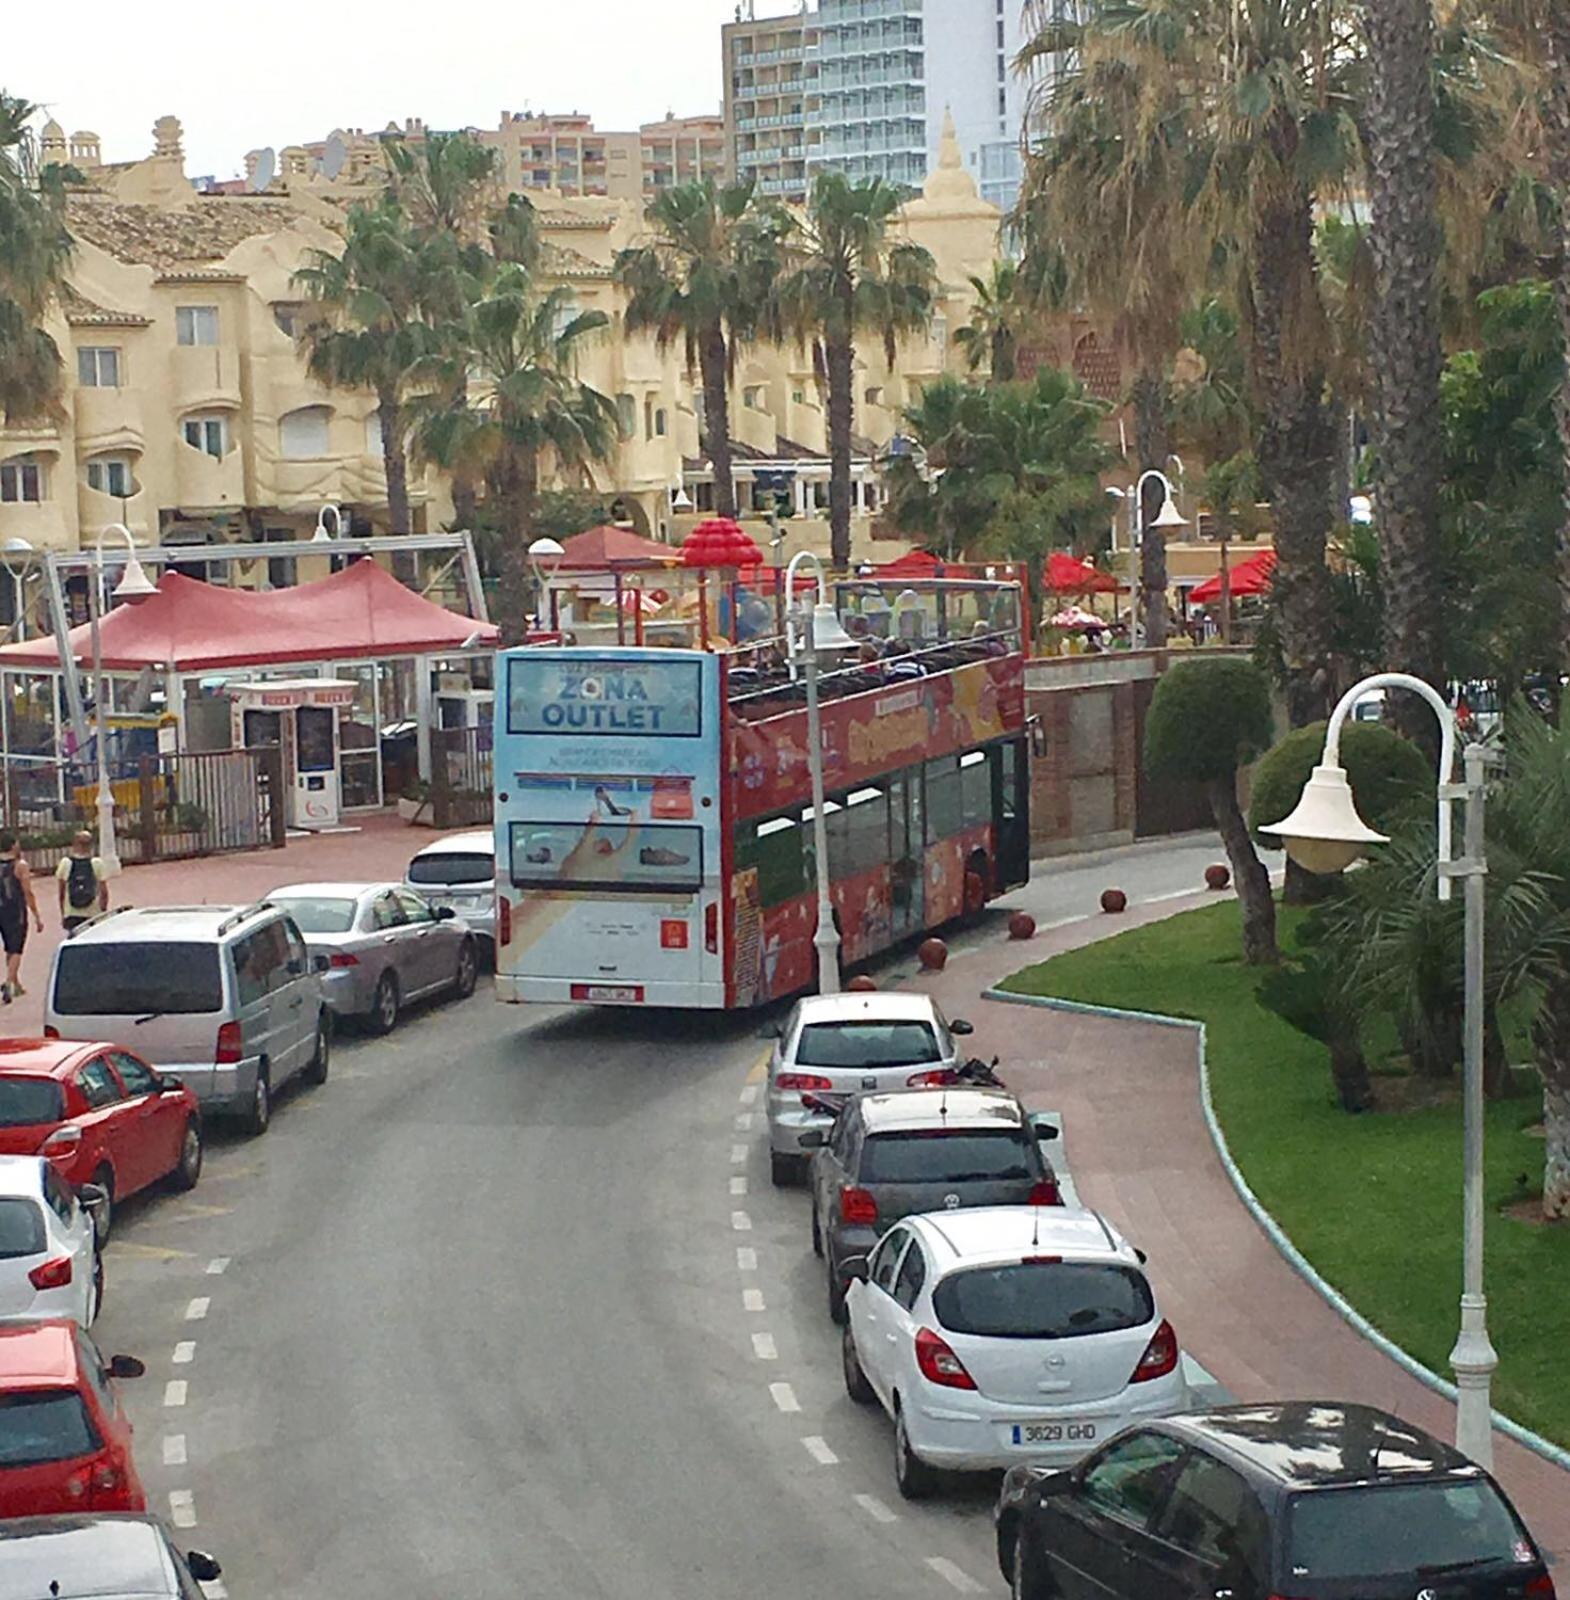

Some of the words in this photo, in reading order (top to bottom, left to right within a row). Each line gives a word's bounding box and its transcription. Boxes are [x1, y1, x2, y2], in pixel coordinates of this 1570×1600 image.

[559, 674, 648, 701] ZONA
[542, 703, 665, 729] OUTLET
[1025, 1425, 1062, 1441] 3629
